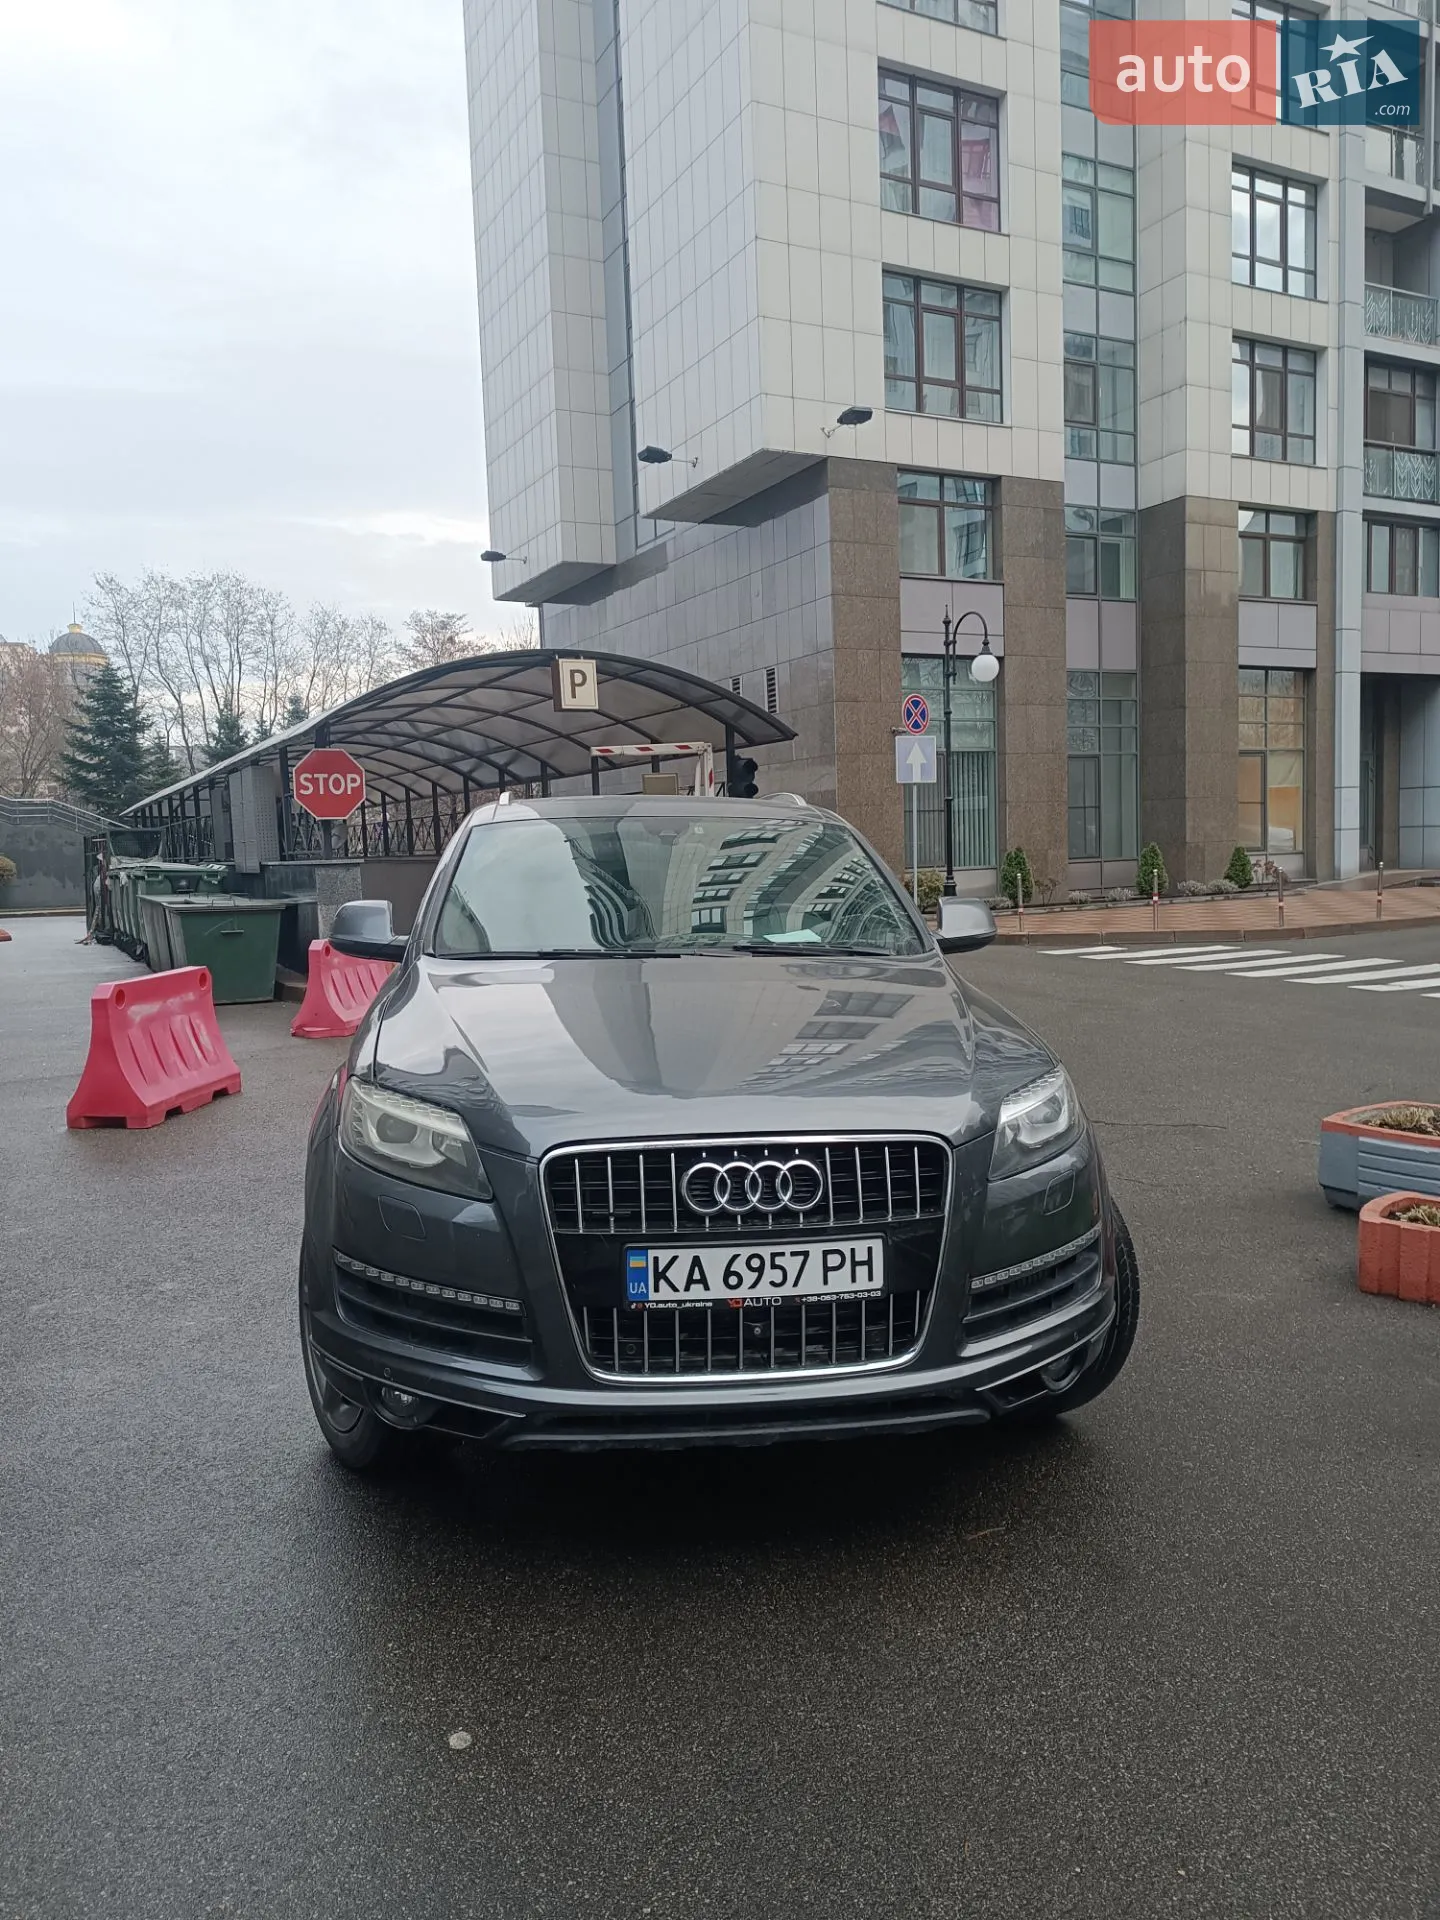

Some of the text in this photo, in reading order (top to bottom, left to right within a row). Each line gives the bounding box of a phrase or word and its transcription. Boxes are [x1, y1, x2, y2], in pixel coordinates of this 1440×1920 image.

[569, 669, 588, 699] P
[299, 773, 361, 795] STOP
[652, 1246, 873, 1293] KA 6957 PH
[629, 1282, 647, 1294] UA
